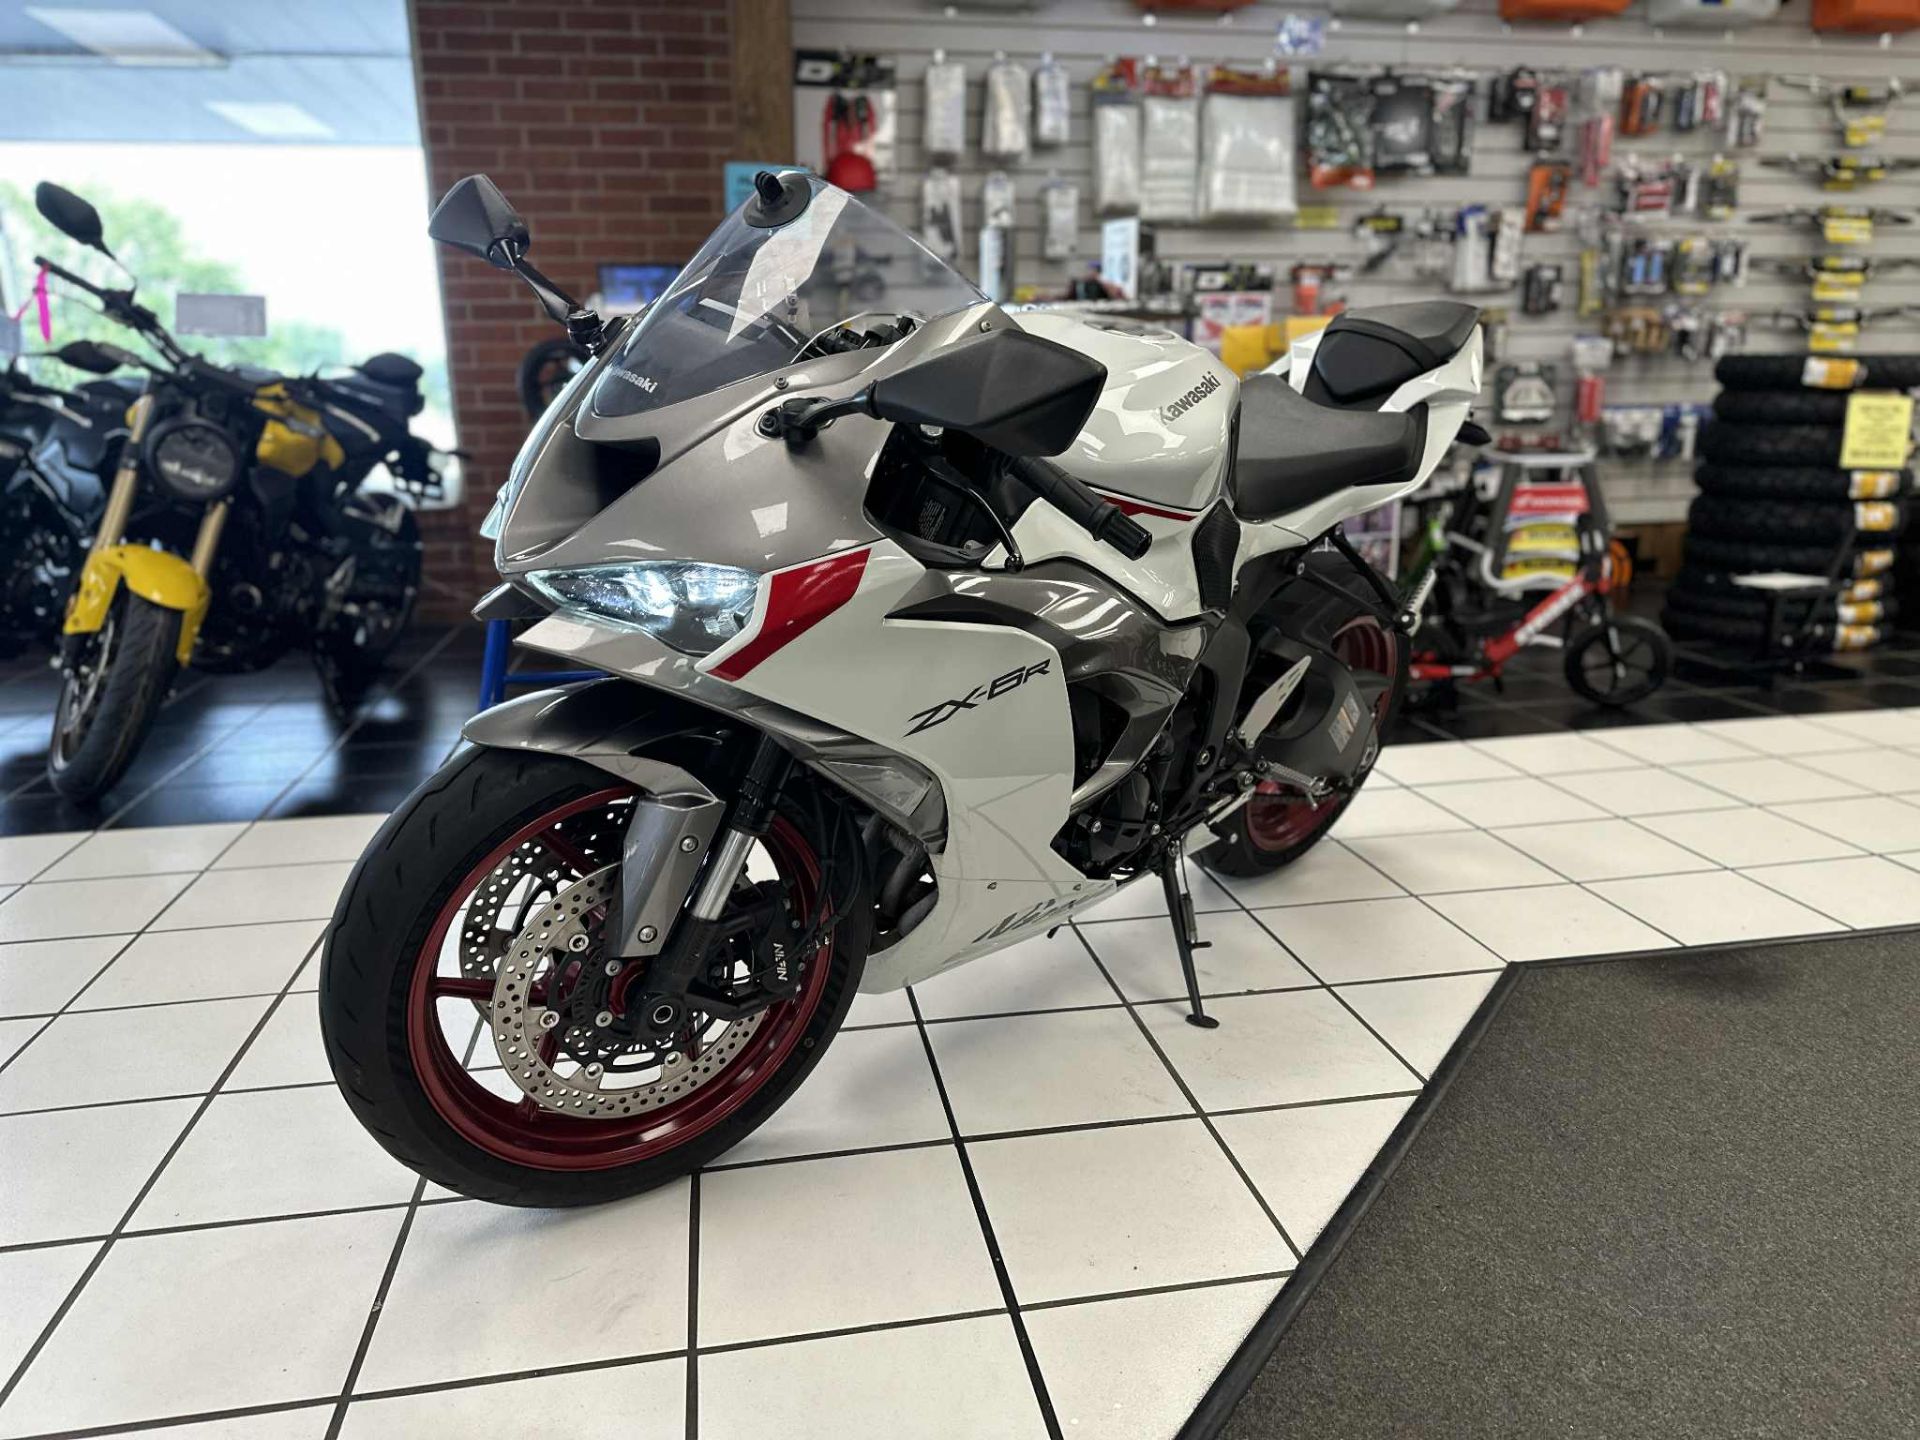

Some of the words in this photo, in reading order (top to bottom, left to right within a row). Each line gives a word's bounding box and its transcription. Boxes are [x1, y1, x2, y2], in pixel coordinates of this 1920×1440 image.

[611, 366, 658, 393] wasaki
[1158, 370, 1221, 426] Kawasaki
[902, 658, 1051, 738] ZX-6R
